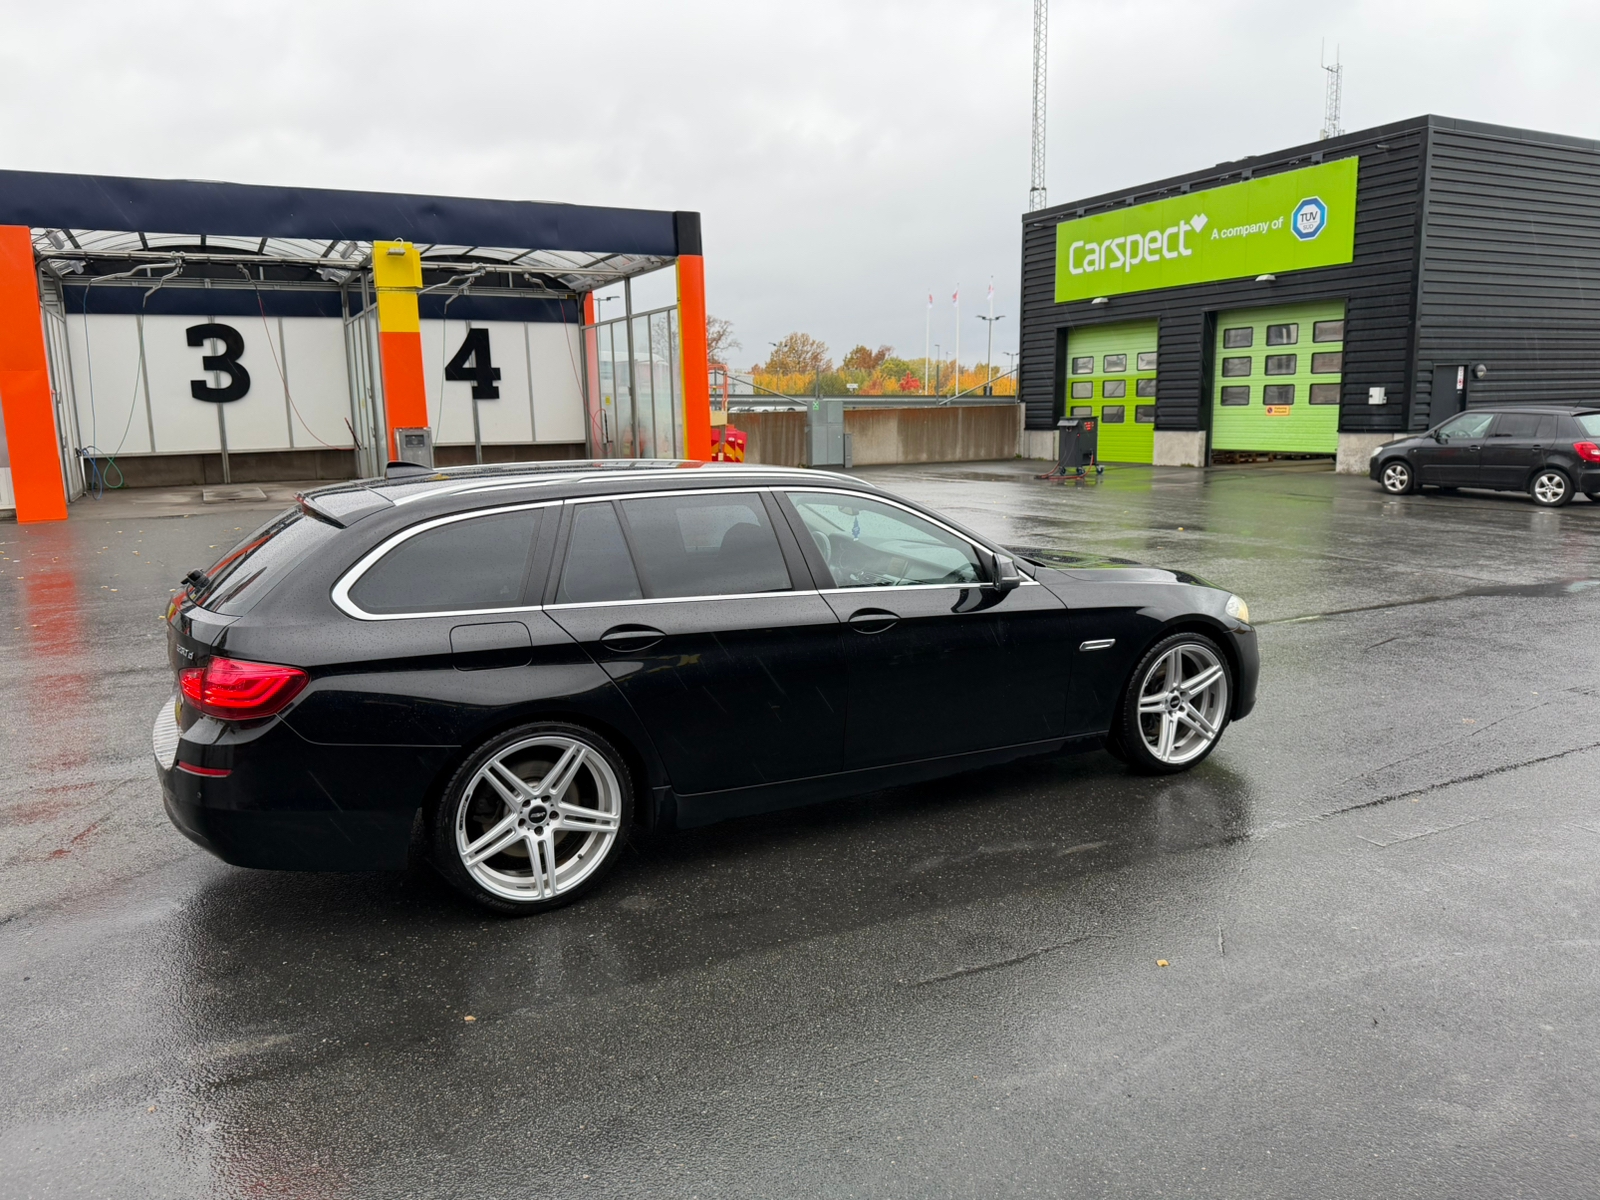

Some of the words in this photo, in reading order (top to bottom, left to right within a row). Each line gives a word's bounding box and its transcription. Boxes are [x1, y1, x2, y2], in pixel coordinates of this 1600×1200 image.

[1069, 219, 1192, 275] Carspect
[1211, 228, 1220, 240] A
[1221, 221, 1270, 237] company
[1271, 216, 1284, 230] of
[186, 323, 250, 403] 3
[445, 328, 501, 399] 4
